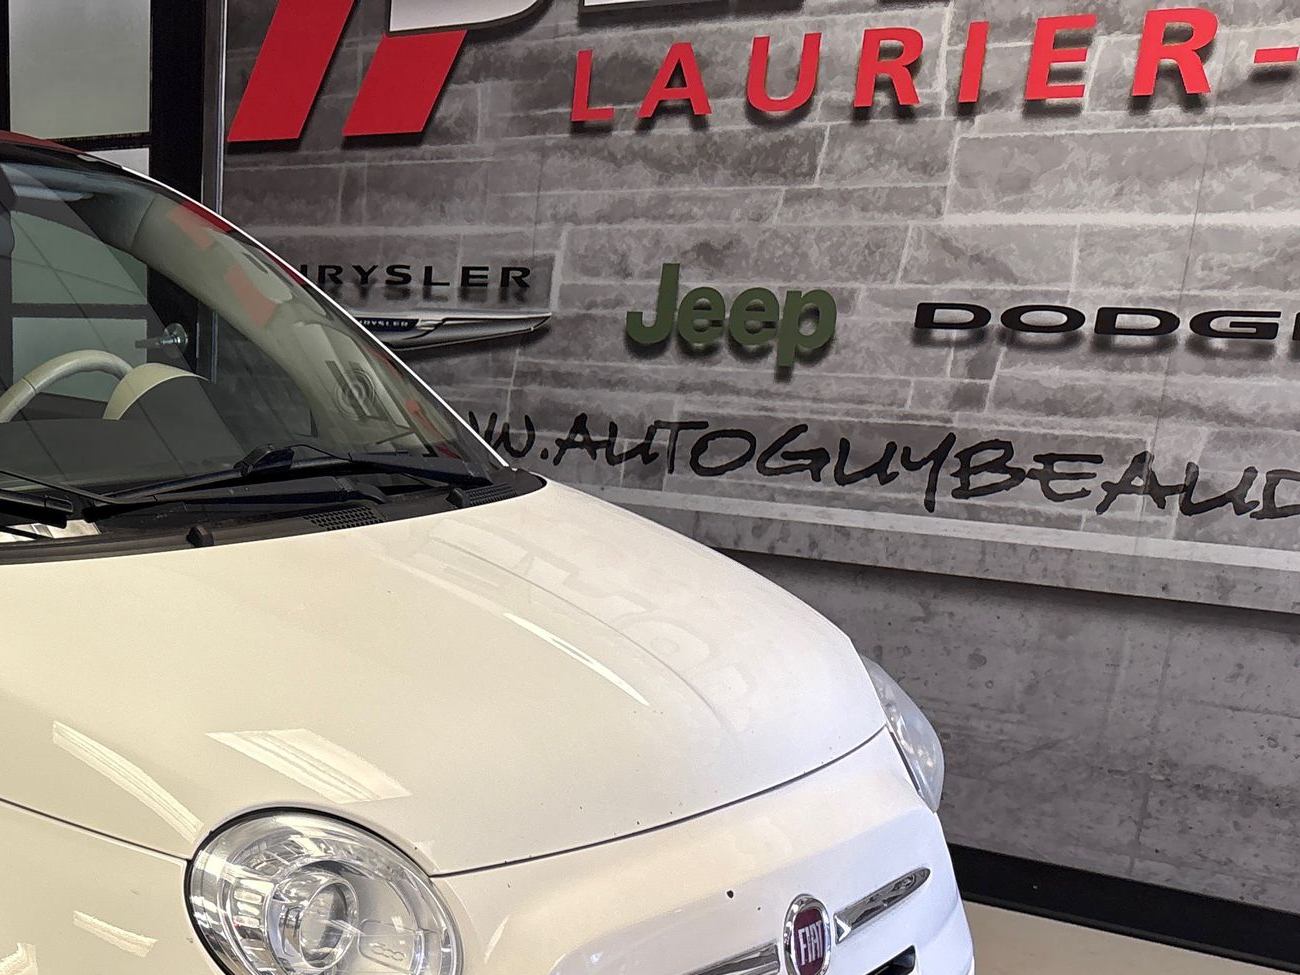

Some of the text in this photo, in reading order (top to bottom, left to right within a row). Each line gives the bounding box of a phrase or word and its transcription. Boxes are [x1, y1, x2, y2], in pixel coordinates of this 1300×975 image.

[300, 263, 531, 289] RYSLER
[625, 263, 838, 367] Jeep
[914, 301, 1300, 341] DODG
[797, 919, 823, 967] FIAT
